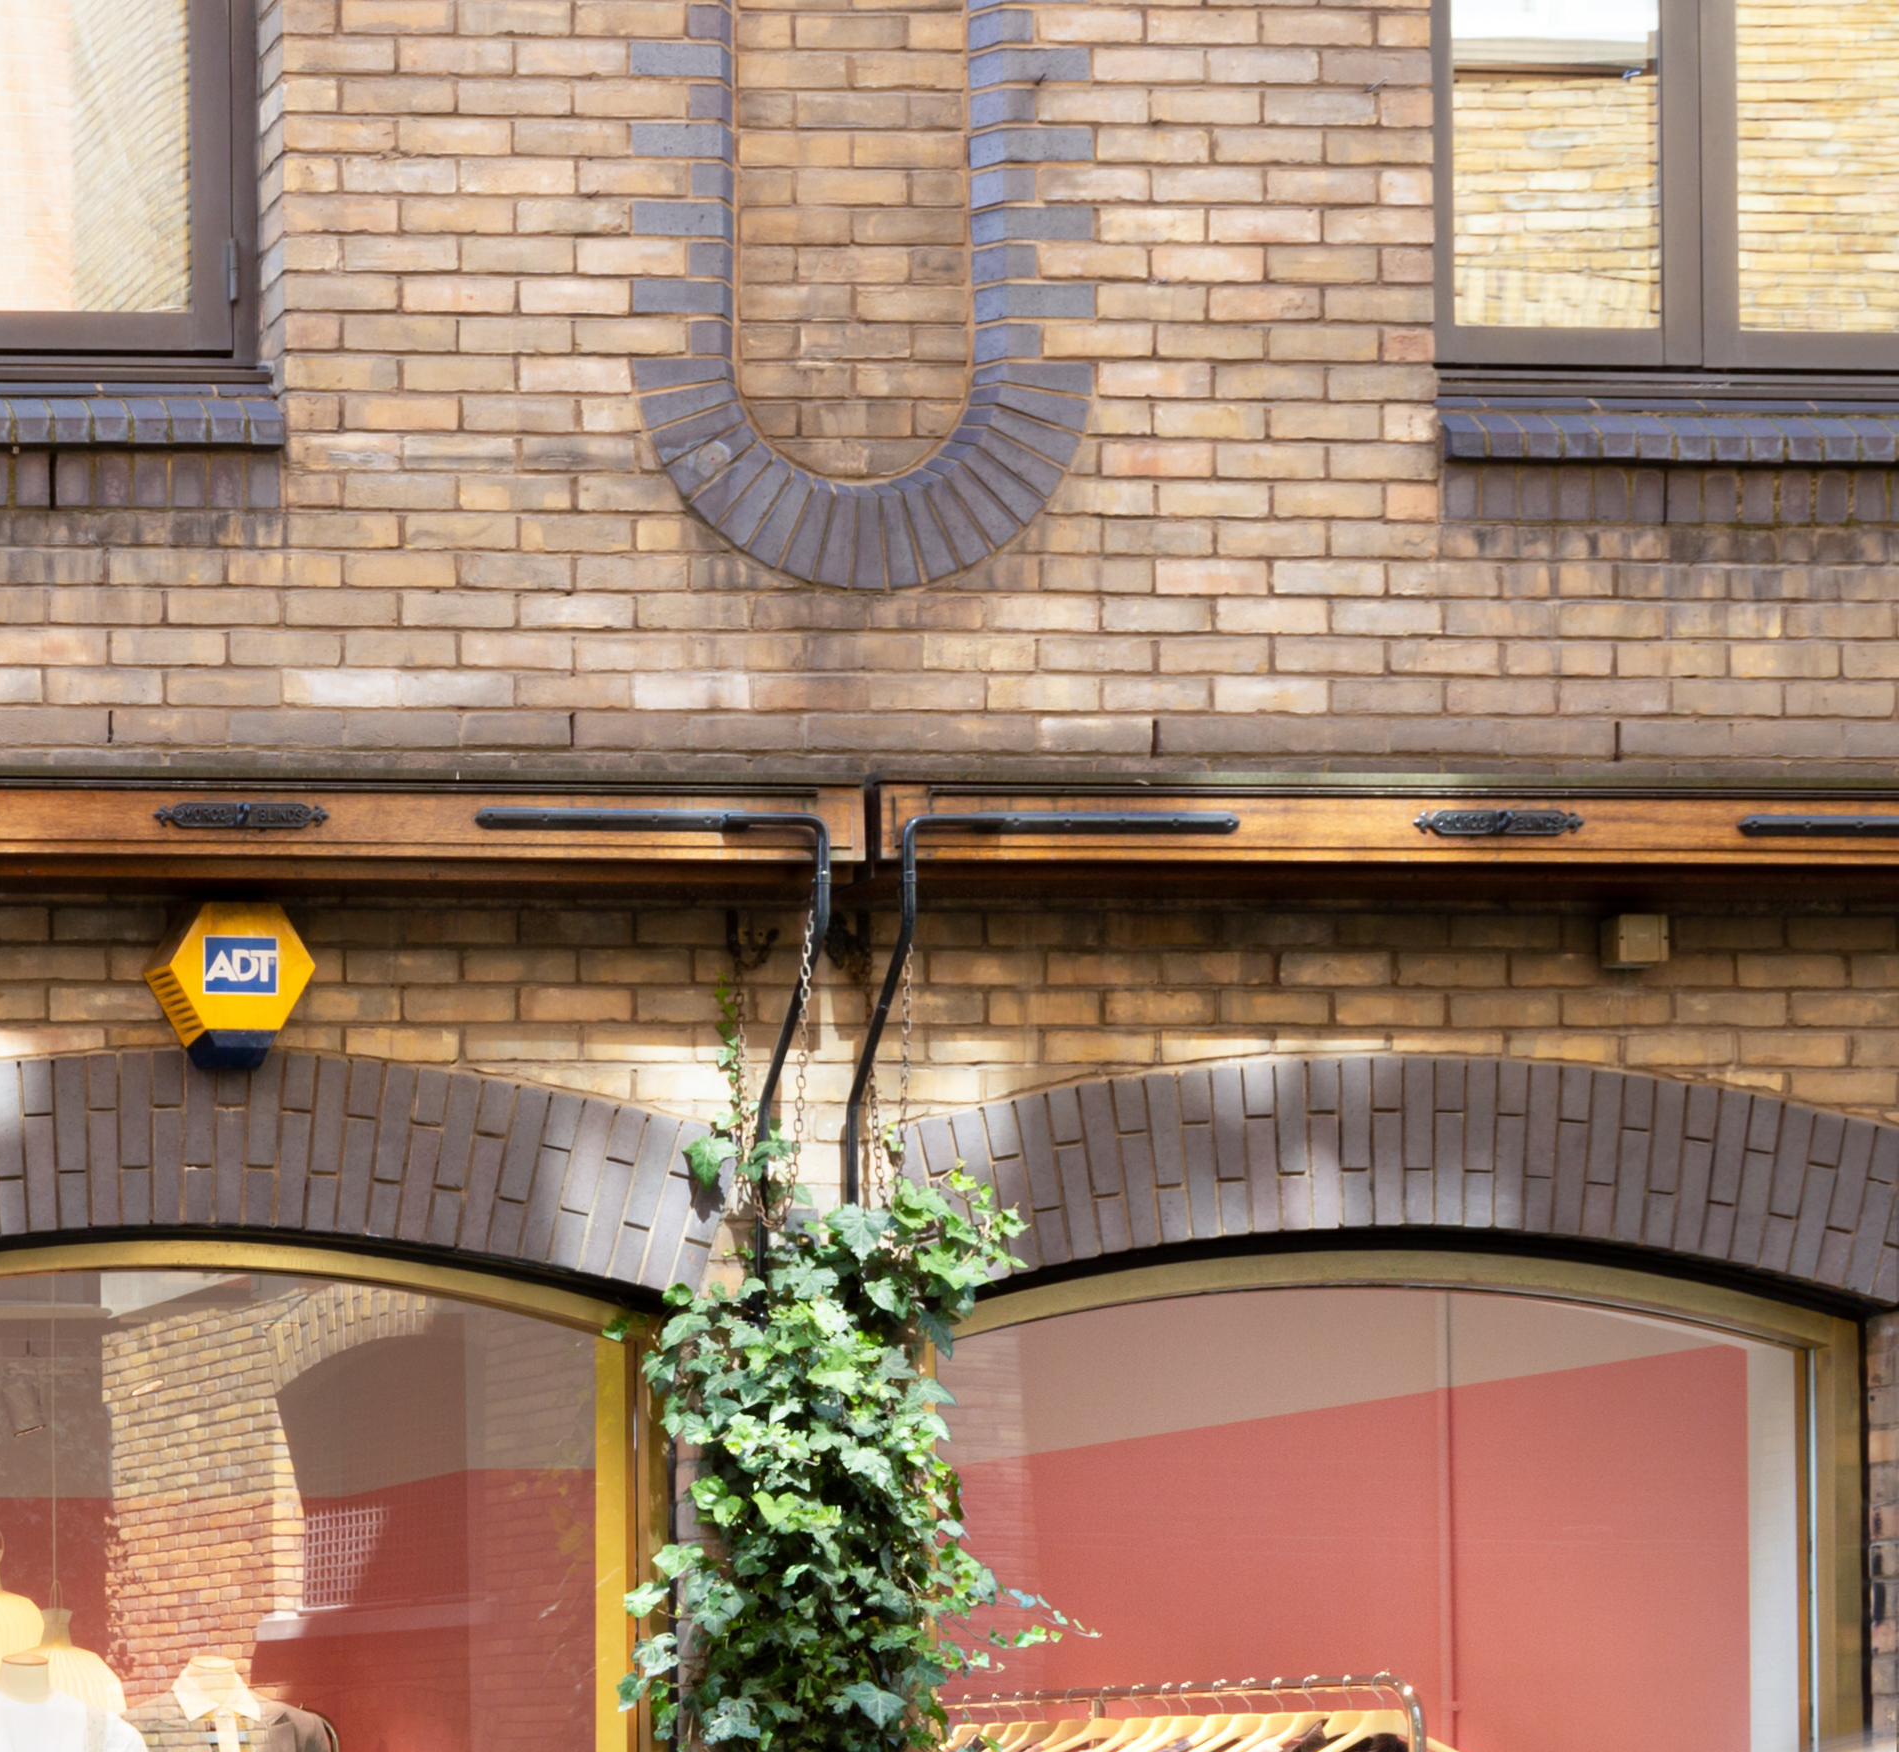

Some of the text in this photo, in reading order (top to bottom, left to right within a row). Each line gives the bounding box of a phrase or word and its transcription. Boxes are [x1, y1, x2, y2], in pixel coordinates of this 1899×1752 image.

[183, 806, 304, 822] MORCO BLINDS
[205, 948, 278, 982] ADT
